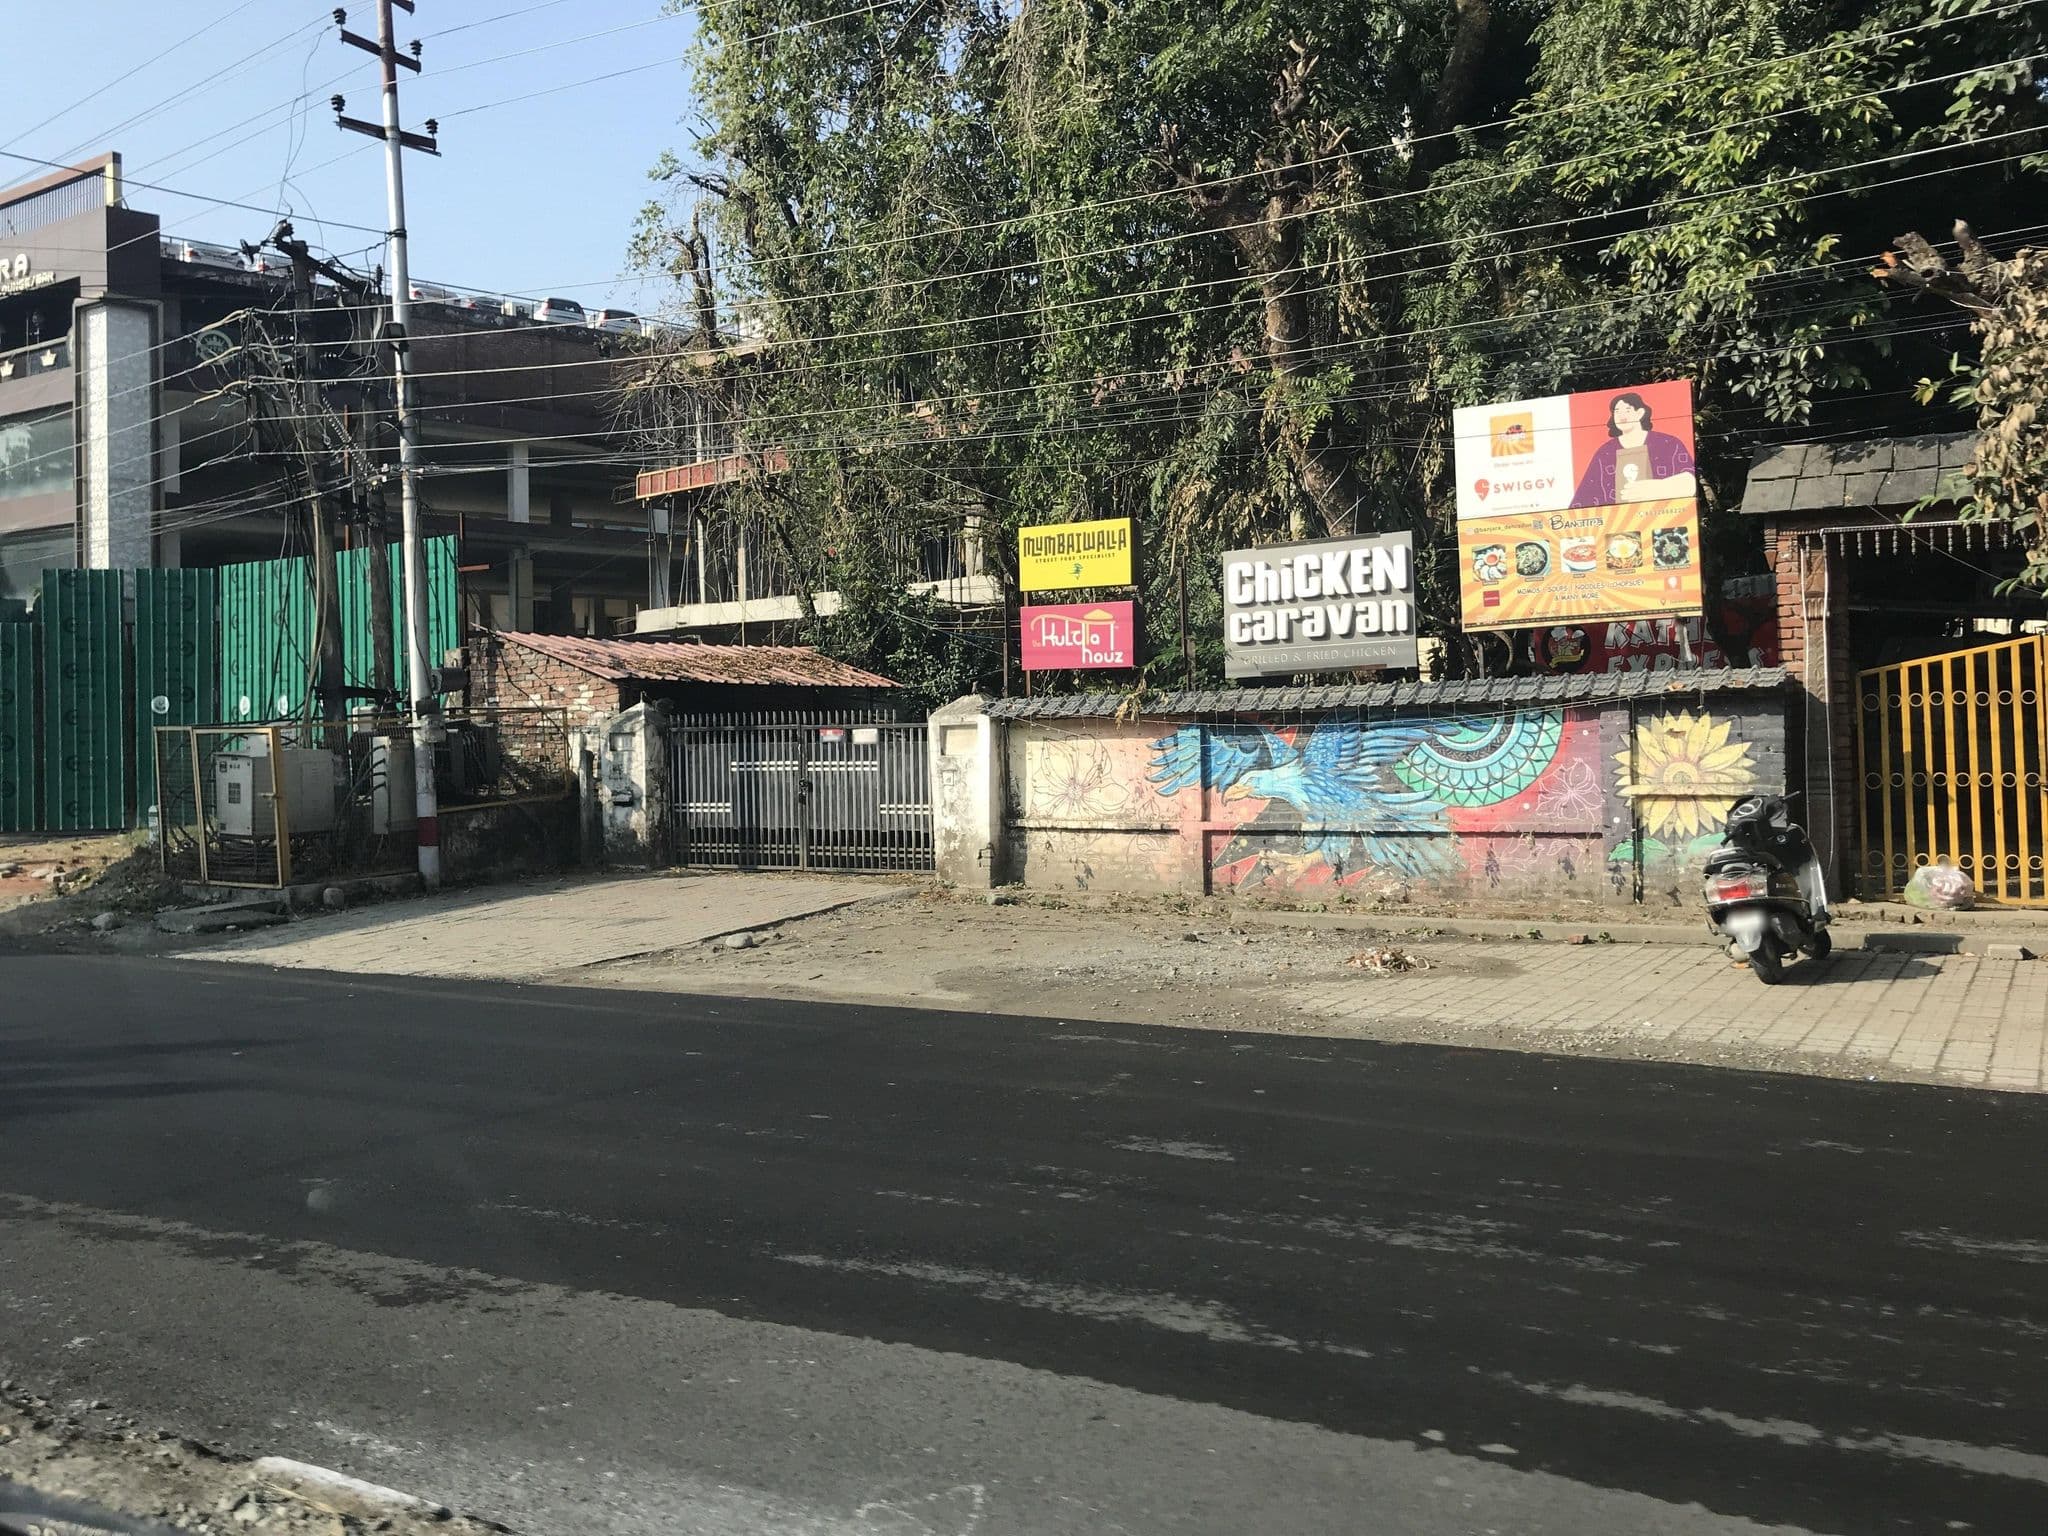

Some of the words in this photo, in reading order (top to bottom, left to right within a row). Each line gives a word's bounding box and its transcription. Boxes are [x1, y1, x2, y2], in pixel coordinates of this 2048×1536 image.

[1493, 477, 1555, 494] SWIGGY
[1229, 599, 1408, 643] caravan
[1243, 653, 1288, 665] GRILLED
[1293, 653, 1302, 662] &
[1307, 650, 1339, 661] FRIED
[1343, 646, 1397, 659] CHICKEN
